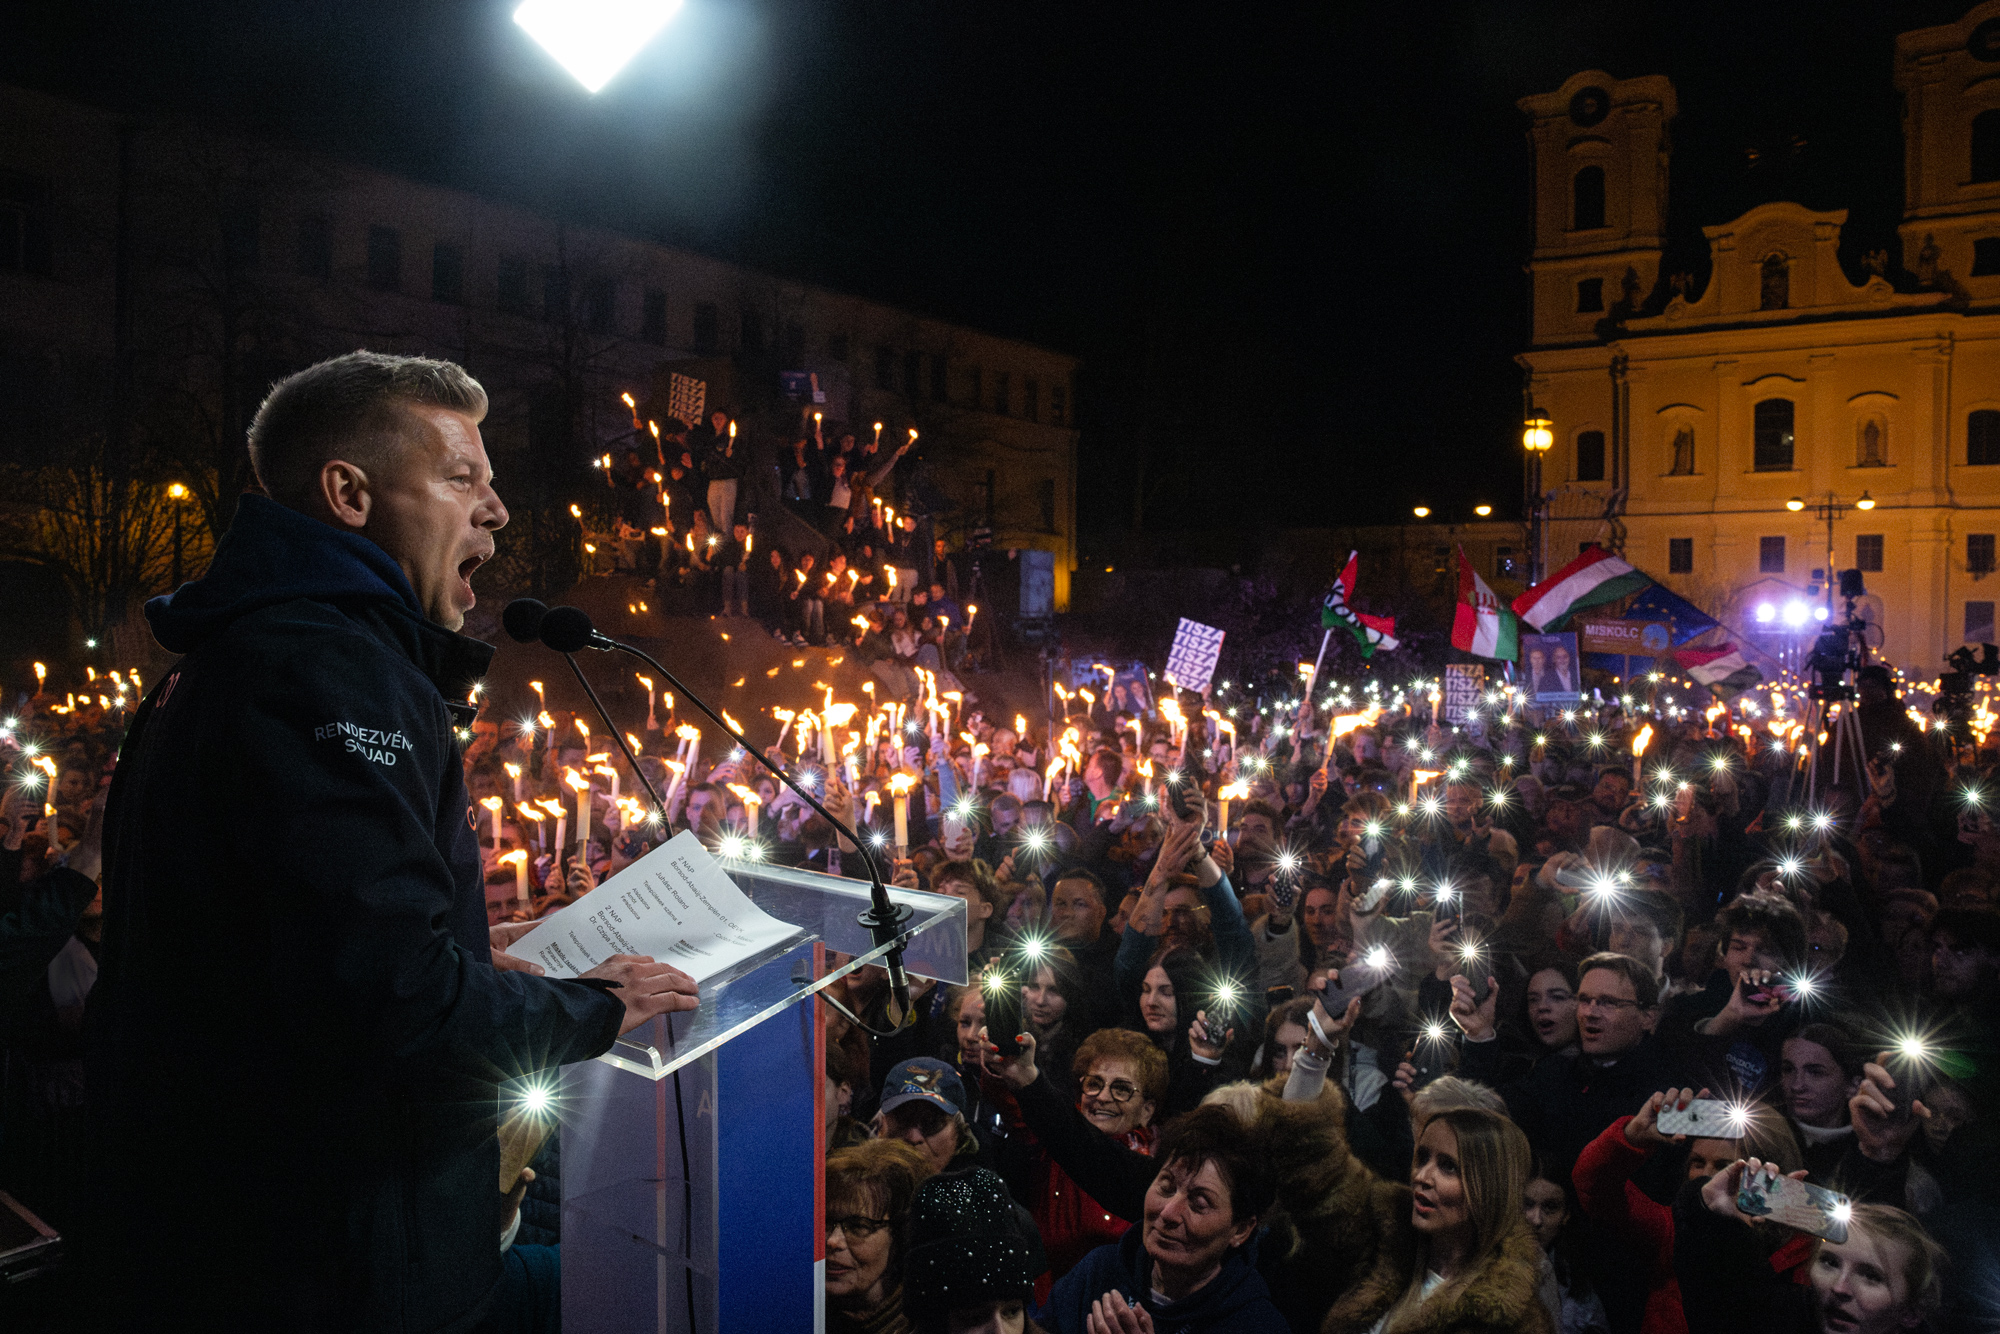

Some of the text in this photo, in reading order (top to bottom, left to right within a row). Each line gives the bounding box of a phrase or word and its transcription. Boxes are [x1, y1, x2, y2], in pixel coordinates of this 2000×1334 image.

[1178, 617, 1225, 642] TISZA
[1585, 624, 1639, 639] MISKOLC
[1174, 630, 1221, 654] TISZA
[1170, 643, 1217, 667] TISZA
[1166, 656, 1213, 680] TISZA
[1446, 664, 1483, 677] TISZA
[315, 722, 414, 751] RENDEZVÉN
[344, 739, 397, 766] SQUAD
[682, 860, 695, 874] NAP
[655, 872, 690, 910] Juhász Roland
[670, 861, 721, 918] Borsod-Abaúj-Zemplén
[609, 910, 622, 923] NAP
[597, 910, 641, 956] Borsod-Abaúj-Zem
[609, 941, 625, 955] Andr
